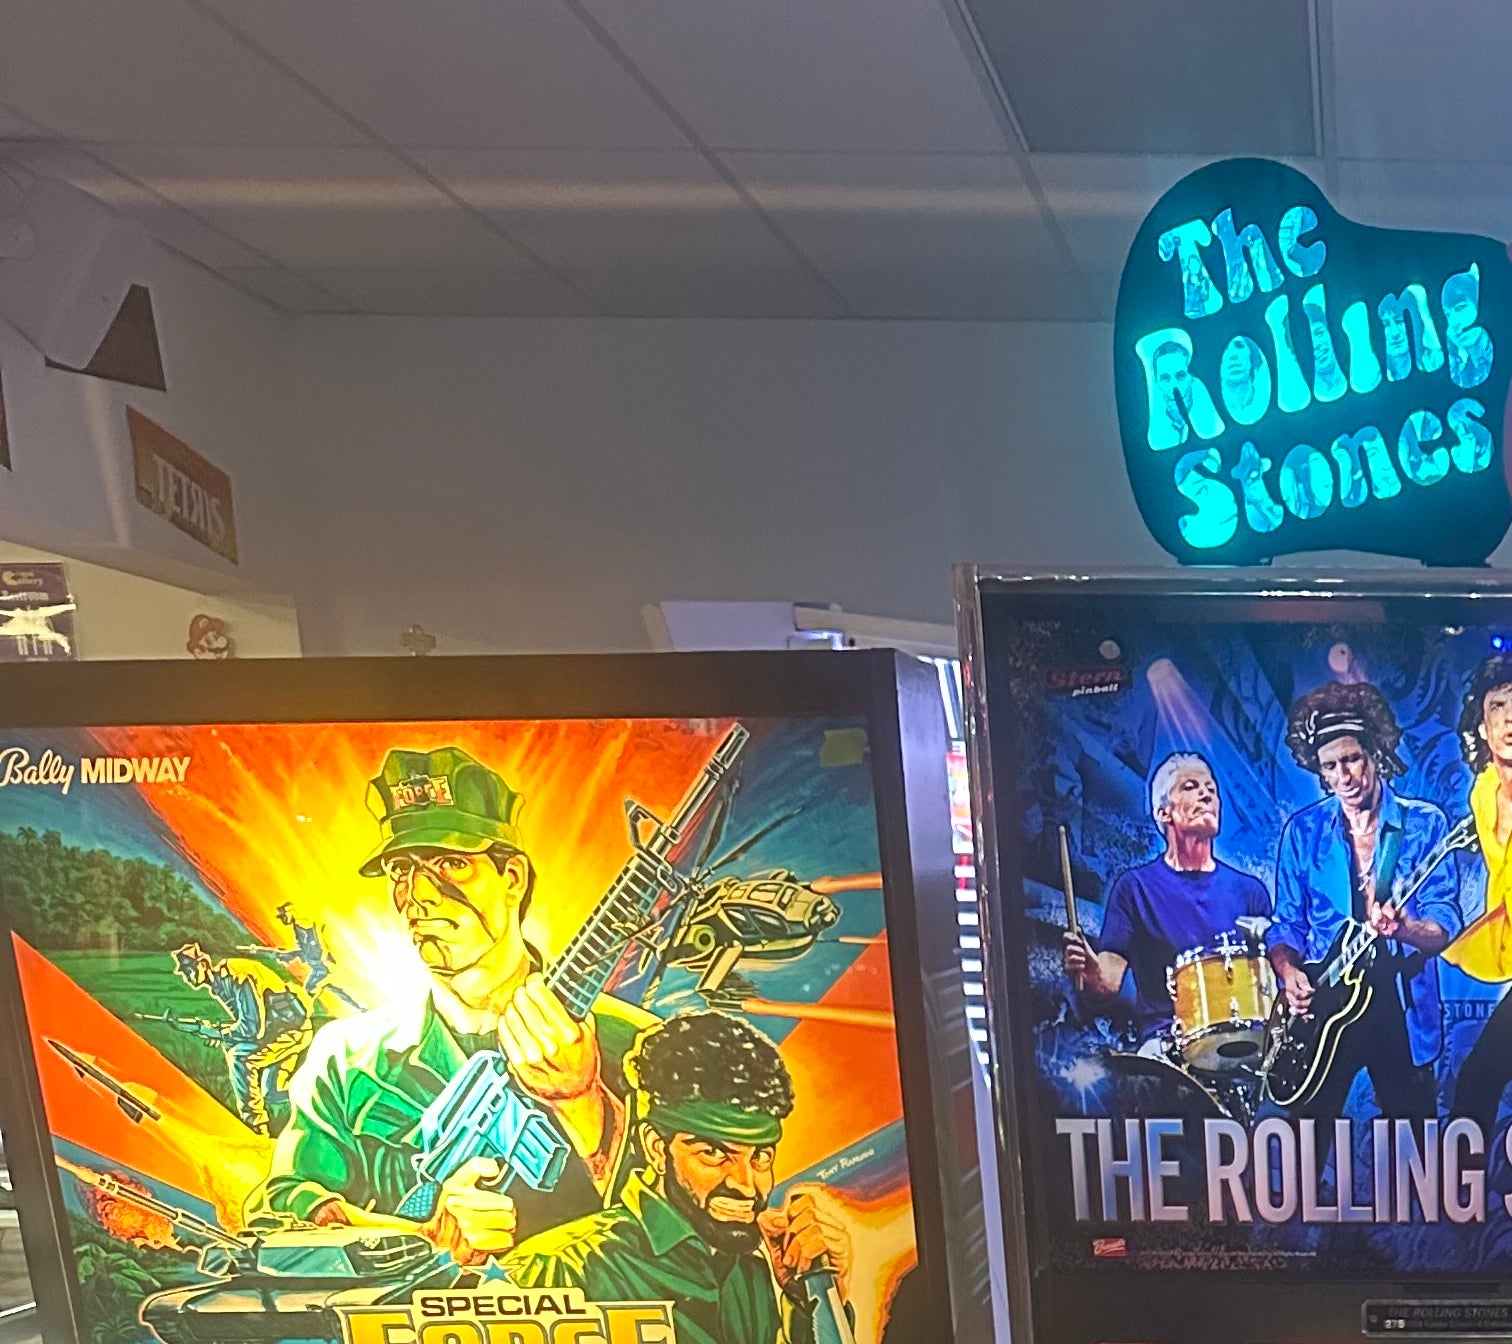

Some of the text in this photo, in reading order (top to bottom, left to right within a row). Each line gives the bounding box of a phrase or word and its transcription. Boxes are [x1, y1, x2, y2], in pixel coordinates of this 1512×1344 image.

[1157, 204, 1327, 320] The
[1134, 262, 1495, 452] Rolling
[1173, 397, 1494, 549] Stones
[1072, 683, 1119, 697] pinball
[0, 747, 191, 795] Bally MIDWAY
[1055, 1117, 1189, 1222] THE
[1203, 1116, 1486, 1223] ROLLING
[420, 1294, 587, 1317] SPECIAL
